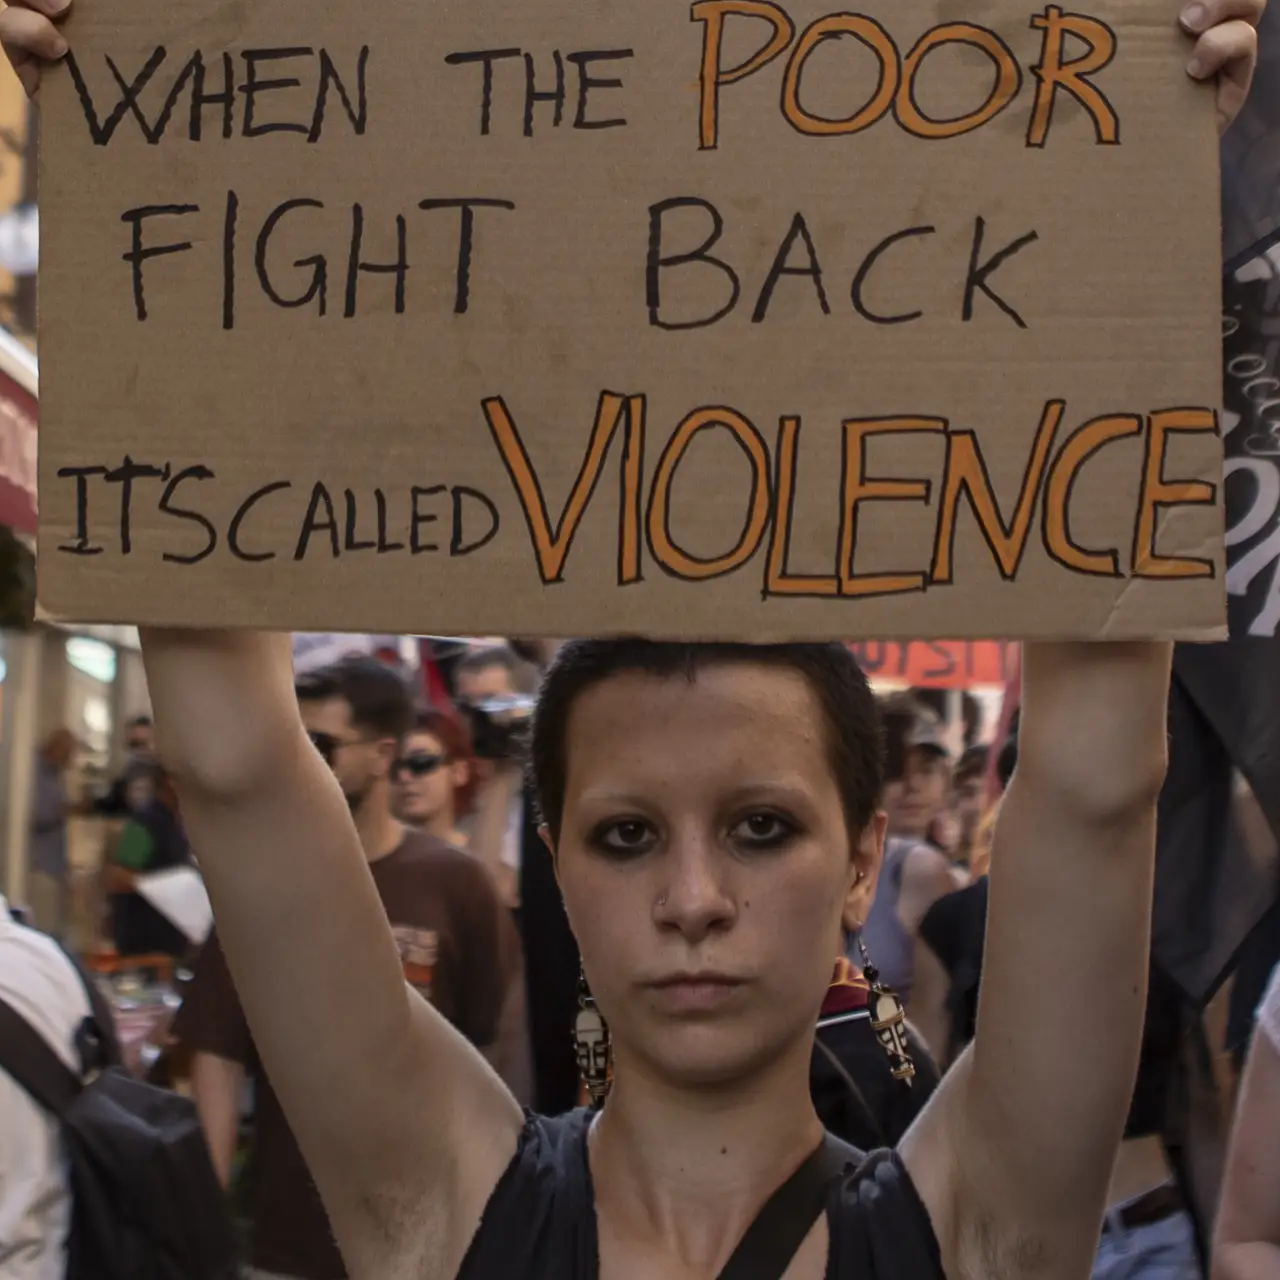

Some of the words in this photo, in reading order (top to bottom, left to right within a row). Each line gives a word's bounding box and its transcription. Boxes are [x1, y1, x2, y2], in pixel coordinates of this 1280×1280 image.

[59, 45, 369, 145] WHEN
[444, 47, 635, 138] THE
[122, 190, 515, 329] FIGHT
[646, 196, 1039, 331] BACK
[227, 481, 500, 562] CALLED
[481, 389, 1219, 601] VIOLENCE
